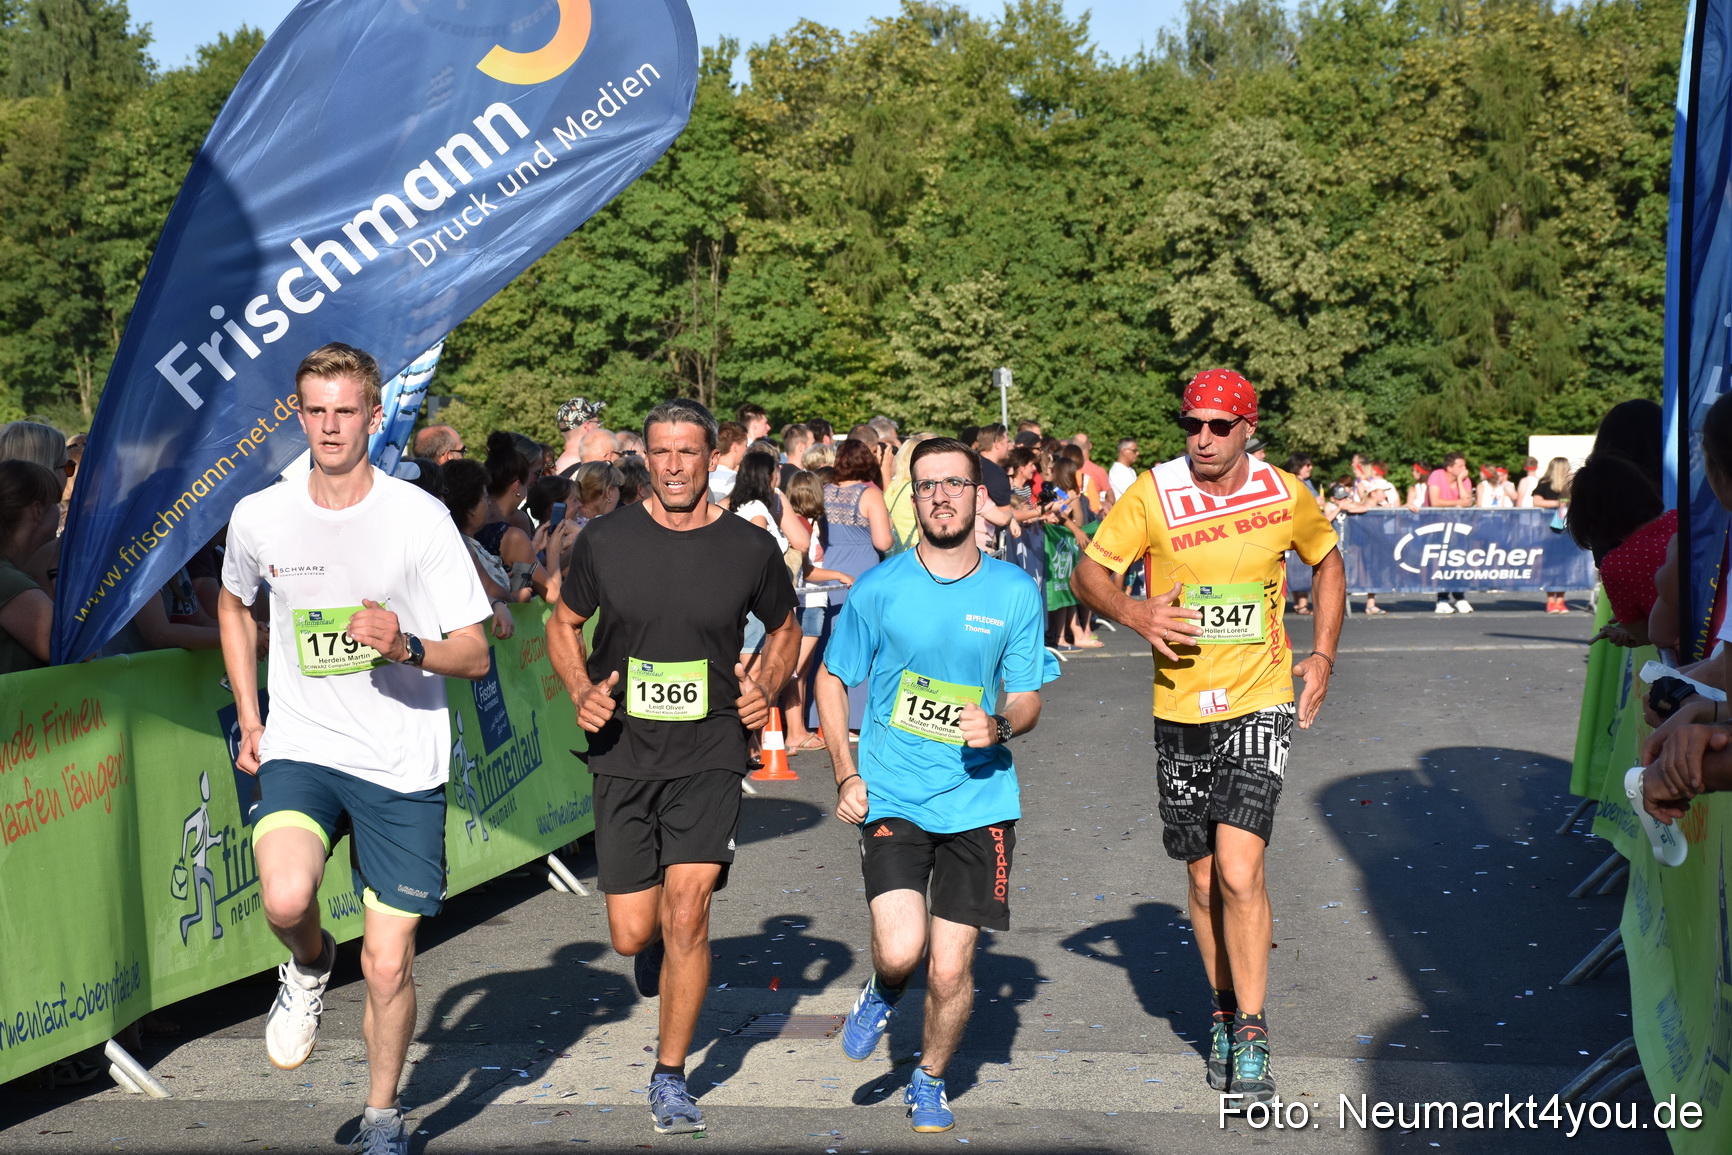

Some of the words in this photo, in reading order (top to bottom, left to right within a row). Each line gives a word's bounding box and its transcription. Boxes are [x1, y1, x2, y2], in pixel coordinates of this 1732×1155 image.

[408, 191, 498, 268] Druck
[498, 138, 558, 200] und
[553, 58, 662, 152] Medien
[154, 101, 531, 411] Frischmann
[74, 393, 300, 623] www.frischmann-net.de
[1170, 524, 1229, 552] MAX
[1235, 508, 1293, 535] BÖGL
[1420, 542, 1544, 568] Fischer
[1431, 568, 1533, 580] AUTOMOBILE
[964, 624, 991, 635] Thomas
[1197, 604, 1256, 628] 1347
[307, 632, 374, 657] 179
[318, 656, 346, 665] Herdeis
[347, 653, 371, 662] Martin
[304, 663, 328, 671] SCHWARZ
[327, 661, 352, 669] Computer
[478, 677, 498, 705] Fischer
[637, 681, 698, 704] 1366
[906, 695, 966, 728] 1542
[908, 717, 930, 728] Mulzer
[931, 724, 956, 735] Thomas
[0, 709, 38, 775] nde
[42, 698, 107, 754] Firmen
[476, 710, 543, 809] firmenlauf
[0, 775, 65, 847] laufen
[61, 731, 129, 815] länger!
[487, 792, 518, 832] neumarkt
[988, 826, 1009, 904] predator
[230, 891, 259, 926] neum
